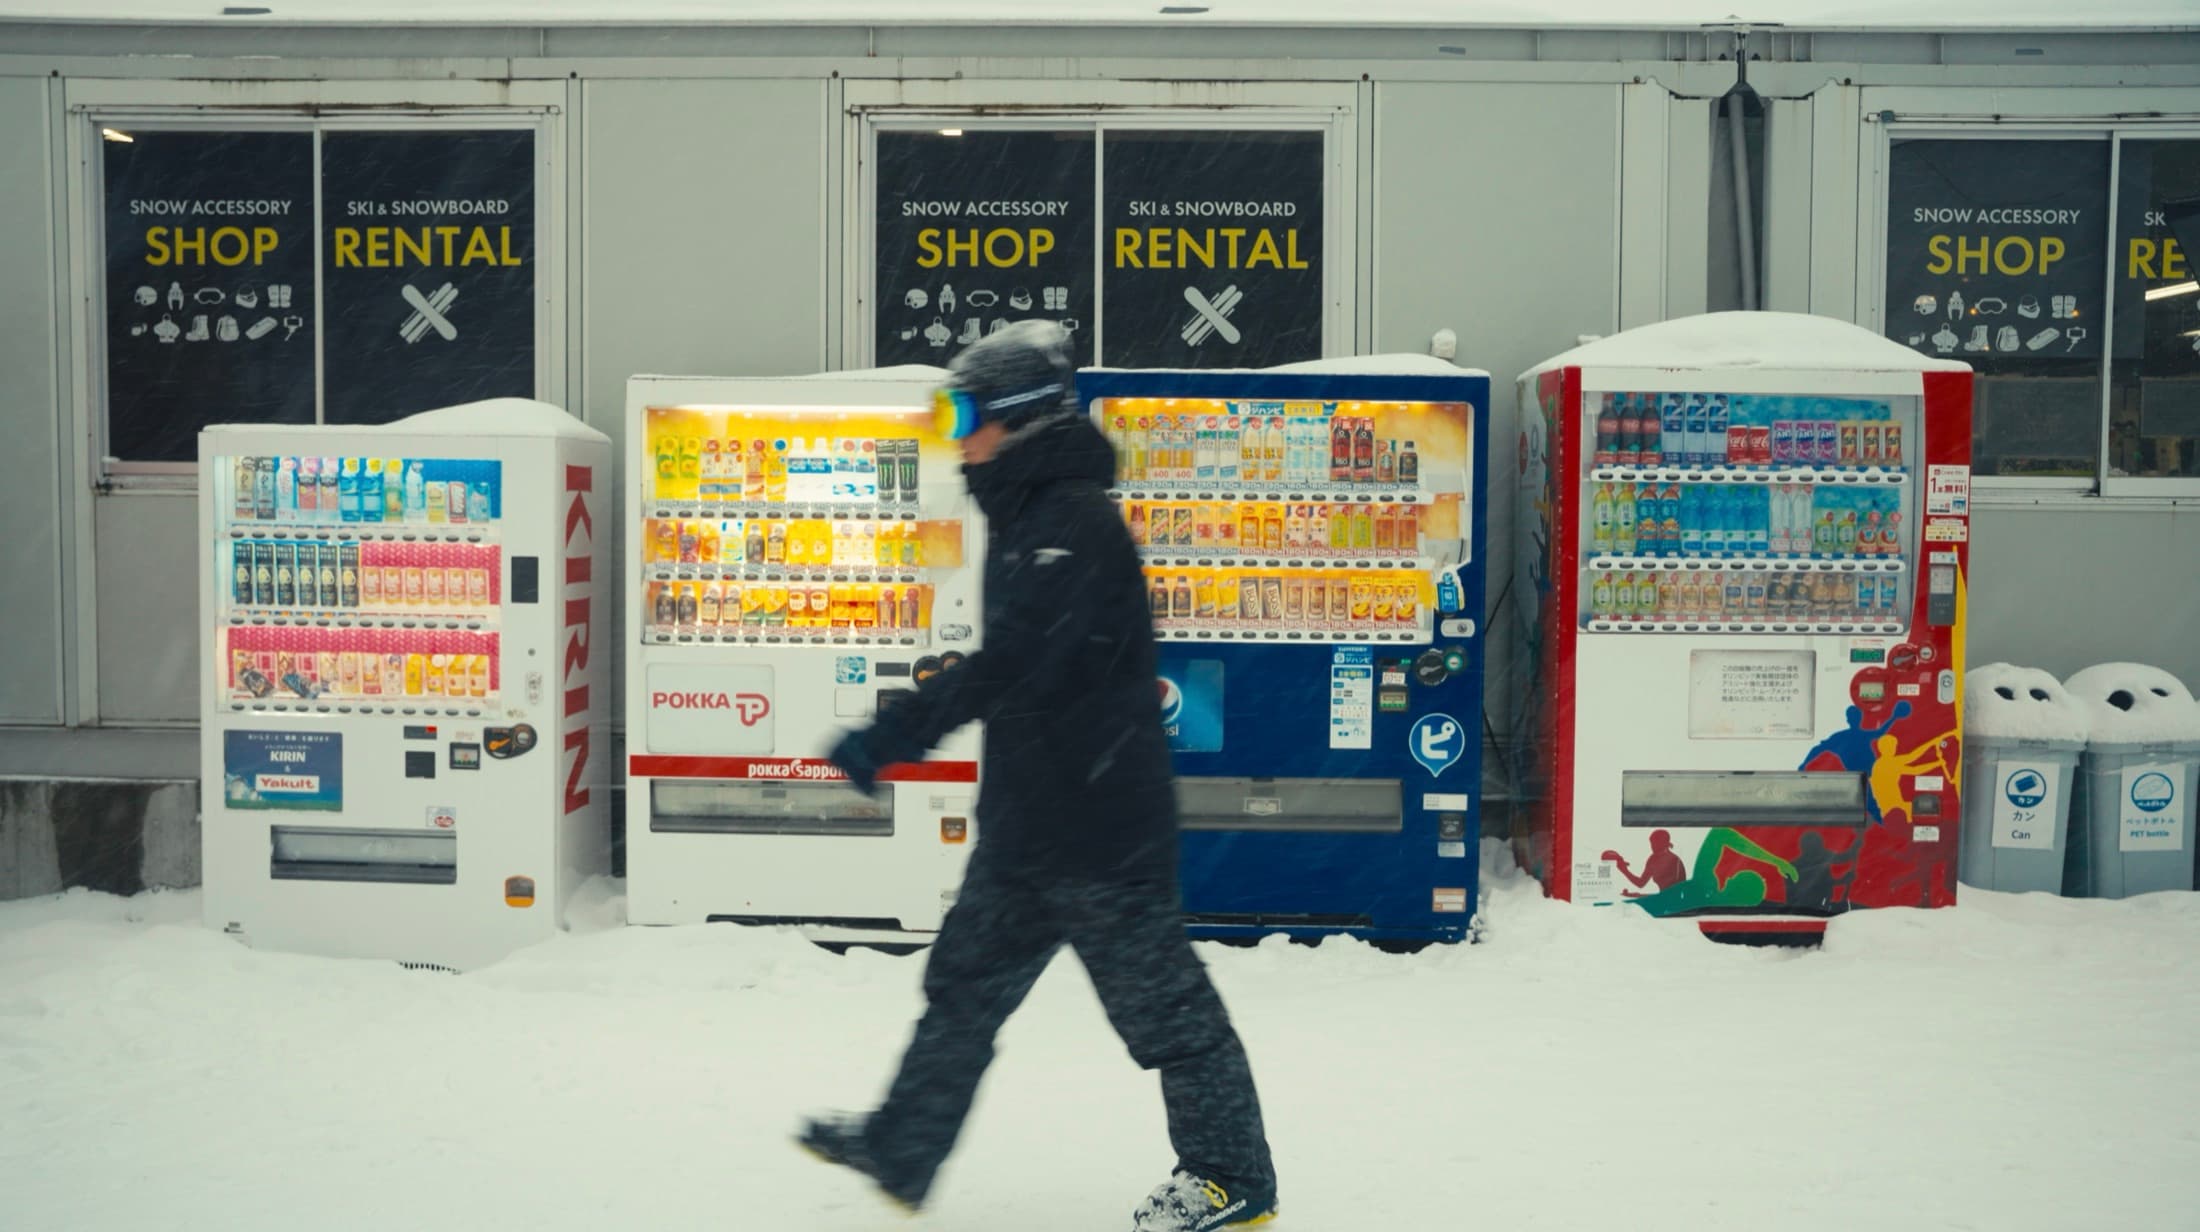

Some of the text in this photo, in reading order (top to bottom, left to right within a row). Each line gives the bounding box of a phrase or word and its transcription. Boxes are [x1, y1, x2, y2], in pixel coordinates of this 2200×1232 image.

[130, 200, 292, 216] SNOW ACCESSORY
[347, 200, 509, 216] SKI & SNOWBOARD
[902, 201, 1069, 217] SNOW ACCESSORY
[1129, 201, 1297, 217] SKI & SNOWBOARD
[1913, 207, 2081, 225] SNOW ACCESSORY
[145, 226, 280, 266] SHOP
[335, 226, 522, 268] RENTAL
[916, 228, 1055, 268] SHOP
[1115, 228, 1309, 269] RENTAL
[1926, 235, 2066, 276] SHOP
[564, 463, 592, 816] KIRIN
[652, 692, 731, 709] POKKA
[270, 750, 306, 762] KIRIN
[748, 763, 790, 778] pokka
[260, 777, 315, 789] Yakult
[2012, 810, 2036, 822] カン
[2011, 829, 2031, 840] Can
